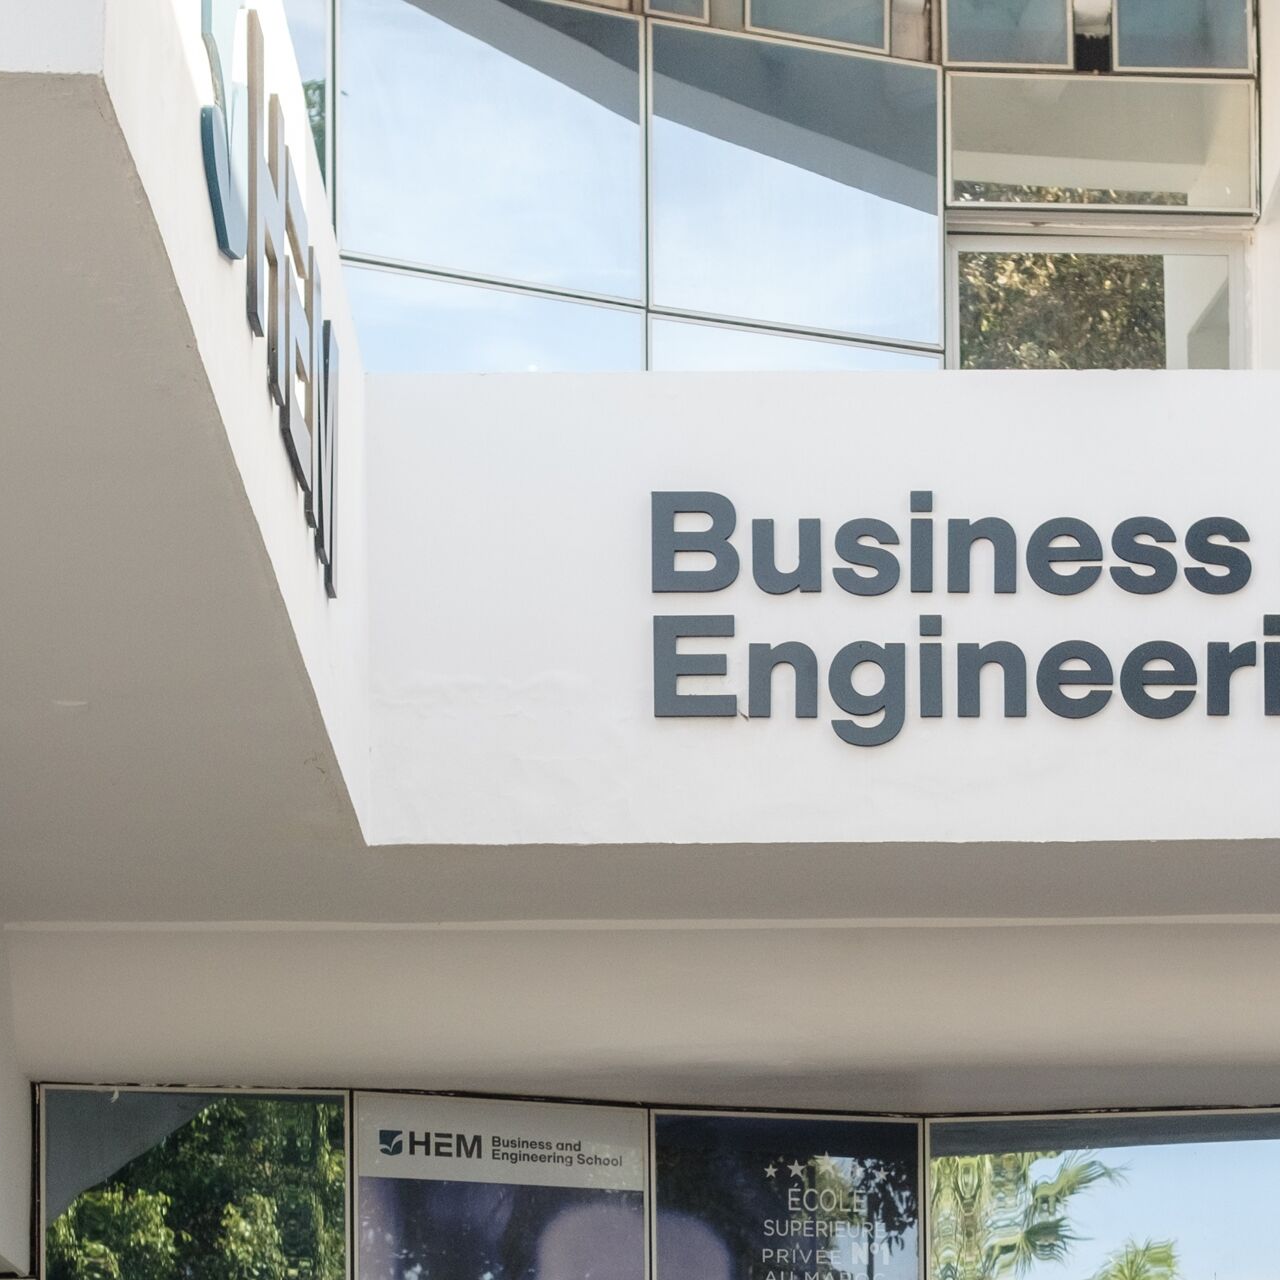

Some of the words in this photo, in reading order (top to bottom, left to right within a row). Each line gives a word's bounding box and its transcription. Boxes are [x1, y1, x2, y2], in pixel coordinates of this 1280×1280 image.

[652, 491, 1251, 596] Business
[409, 1131, 482, 1159] HEM
[492, 1136, 553, 1150] Business
[556, 1140, 581, 1151] and
[492, 1149, 573, 1166] Engineering
[577, 1154, 622, 1167] School
[788, 1183, 869, 1212] ÉCOLE
[764, 1216, 889, 1239] SUPÉRIEURE
[762, 1246, 843, 1265] PRIVÉE
